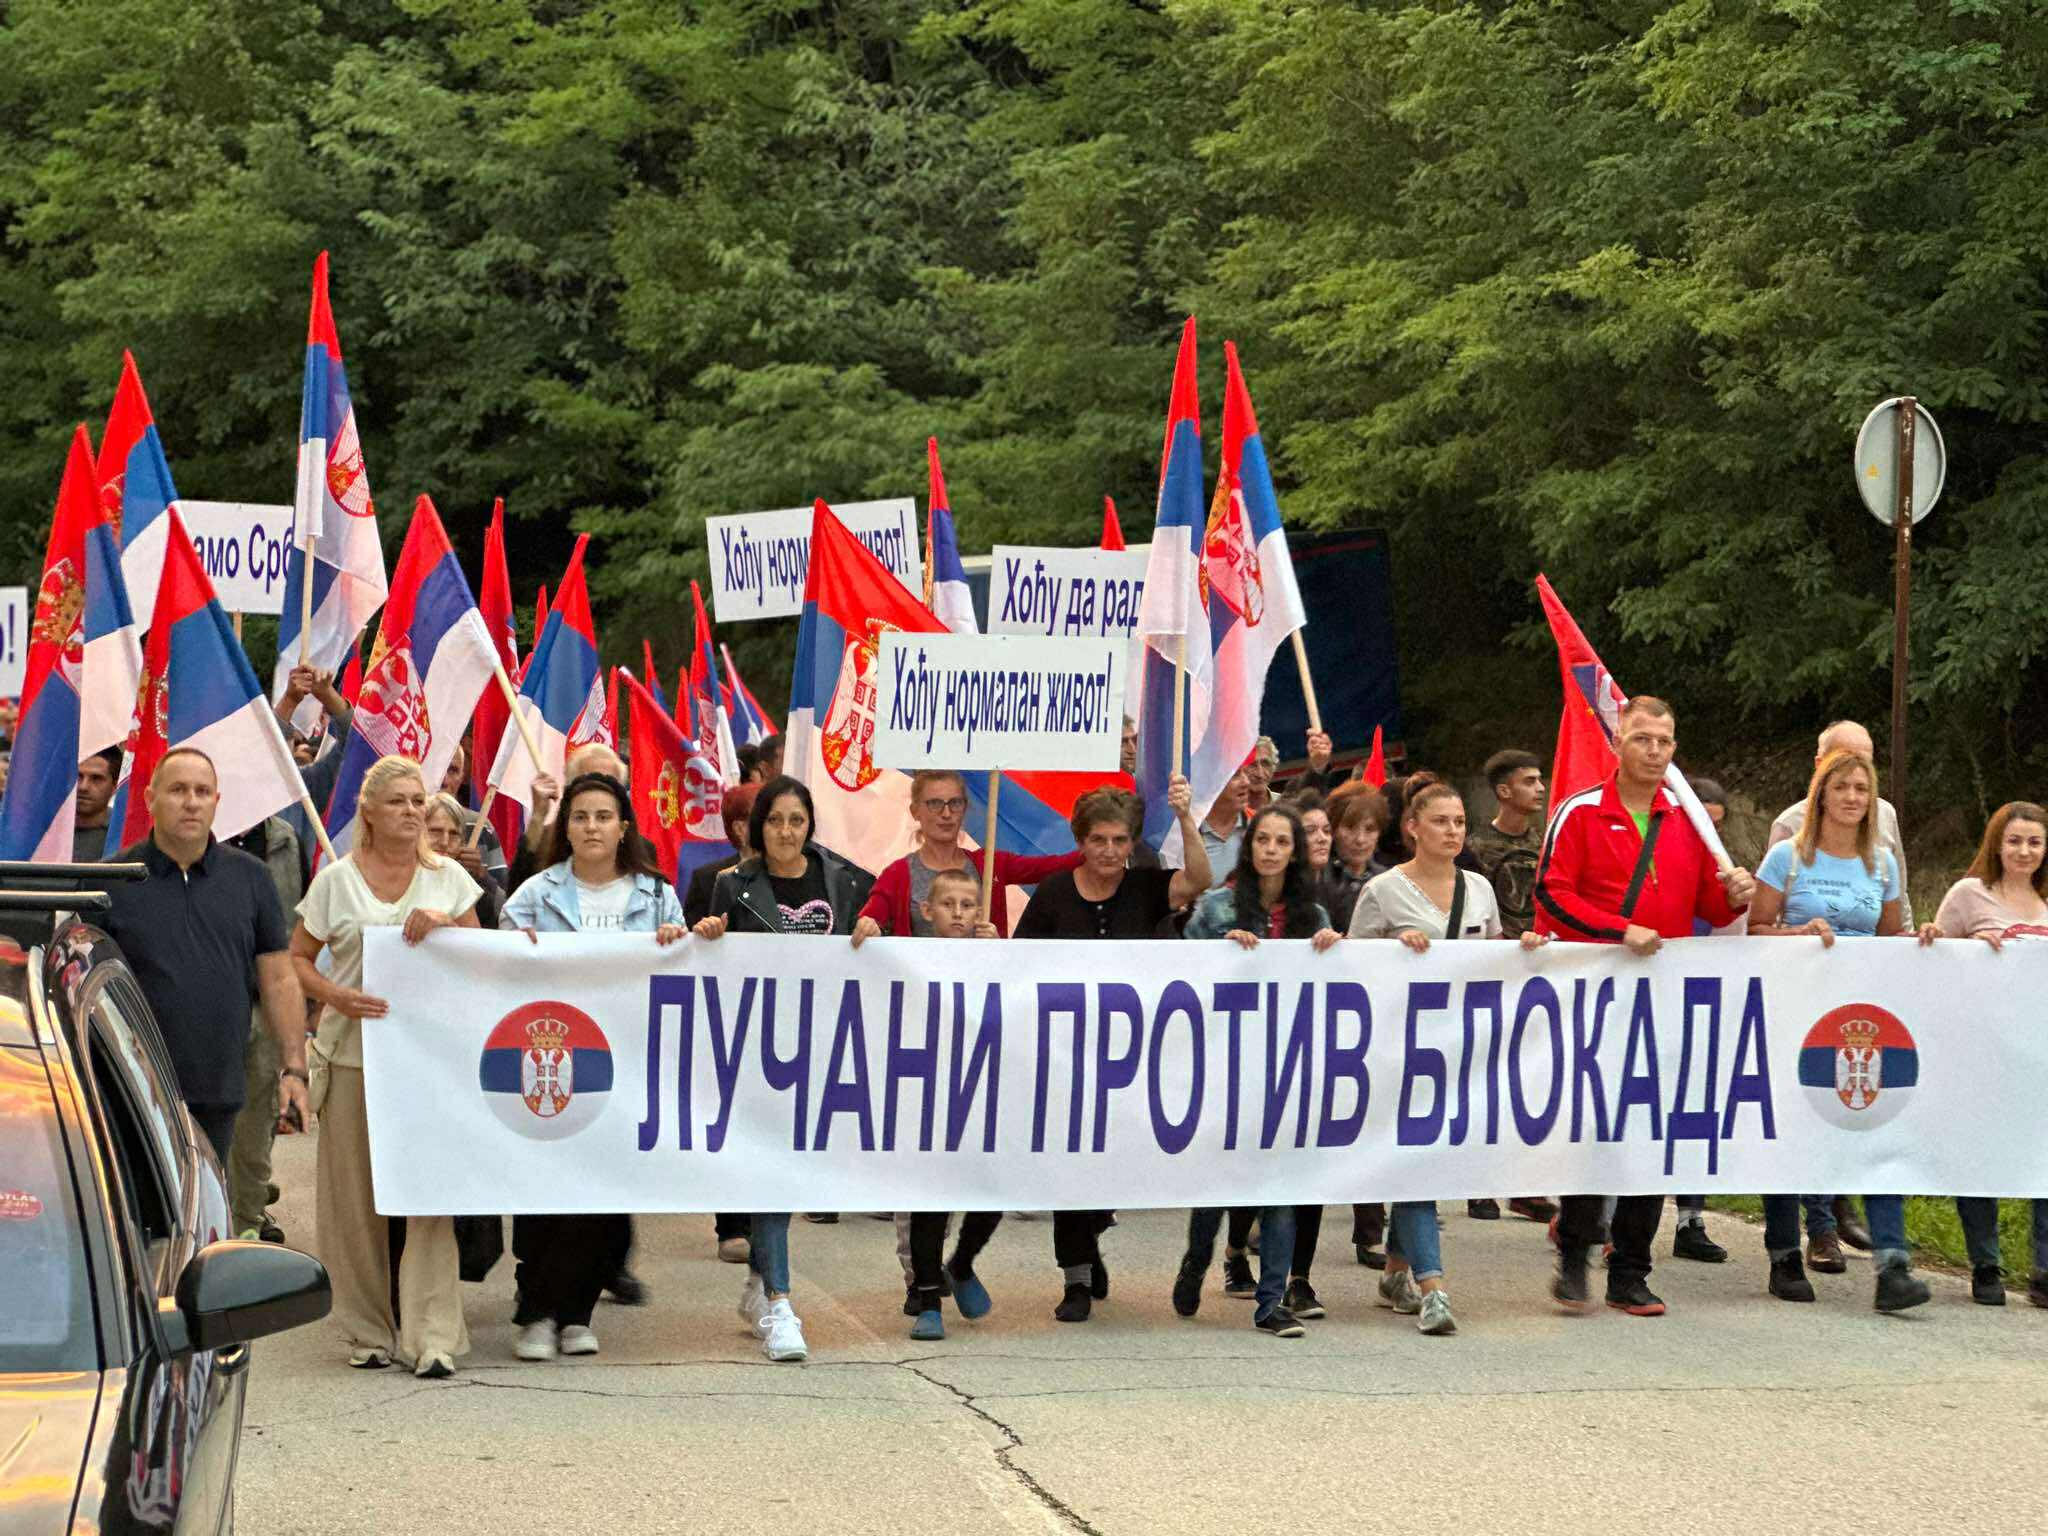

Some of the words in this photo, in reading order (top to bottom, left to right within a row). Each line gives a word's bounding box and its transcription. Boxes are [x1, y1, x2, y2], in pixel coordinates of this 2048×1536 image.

[720, 526, 763, 607] Хоћу
[1001, 557, 1062, 636] Хоћу
[1064, 578, 1096, 637] да
[889, 647, 941, 754] Хоћу
[944, 669, 1041, 753] нормалан
[1045, 651, 1112, 734] живот!
[638, 974, 1002, 1153] ЛУЧАНИ
[1031, 979, 1373, 1155] ПРОТИВ
[1396, 976, 1777, 1176] БЛОКАДА
